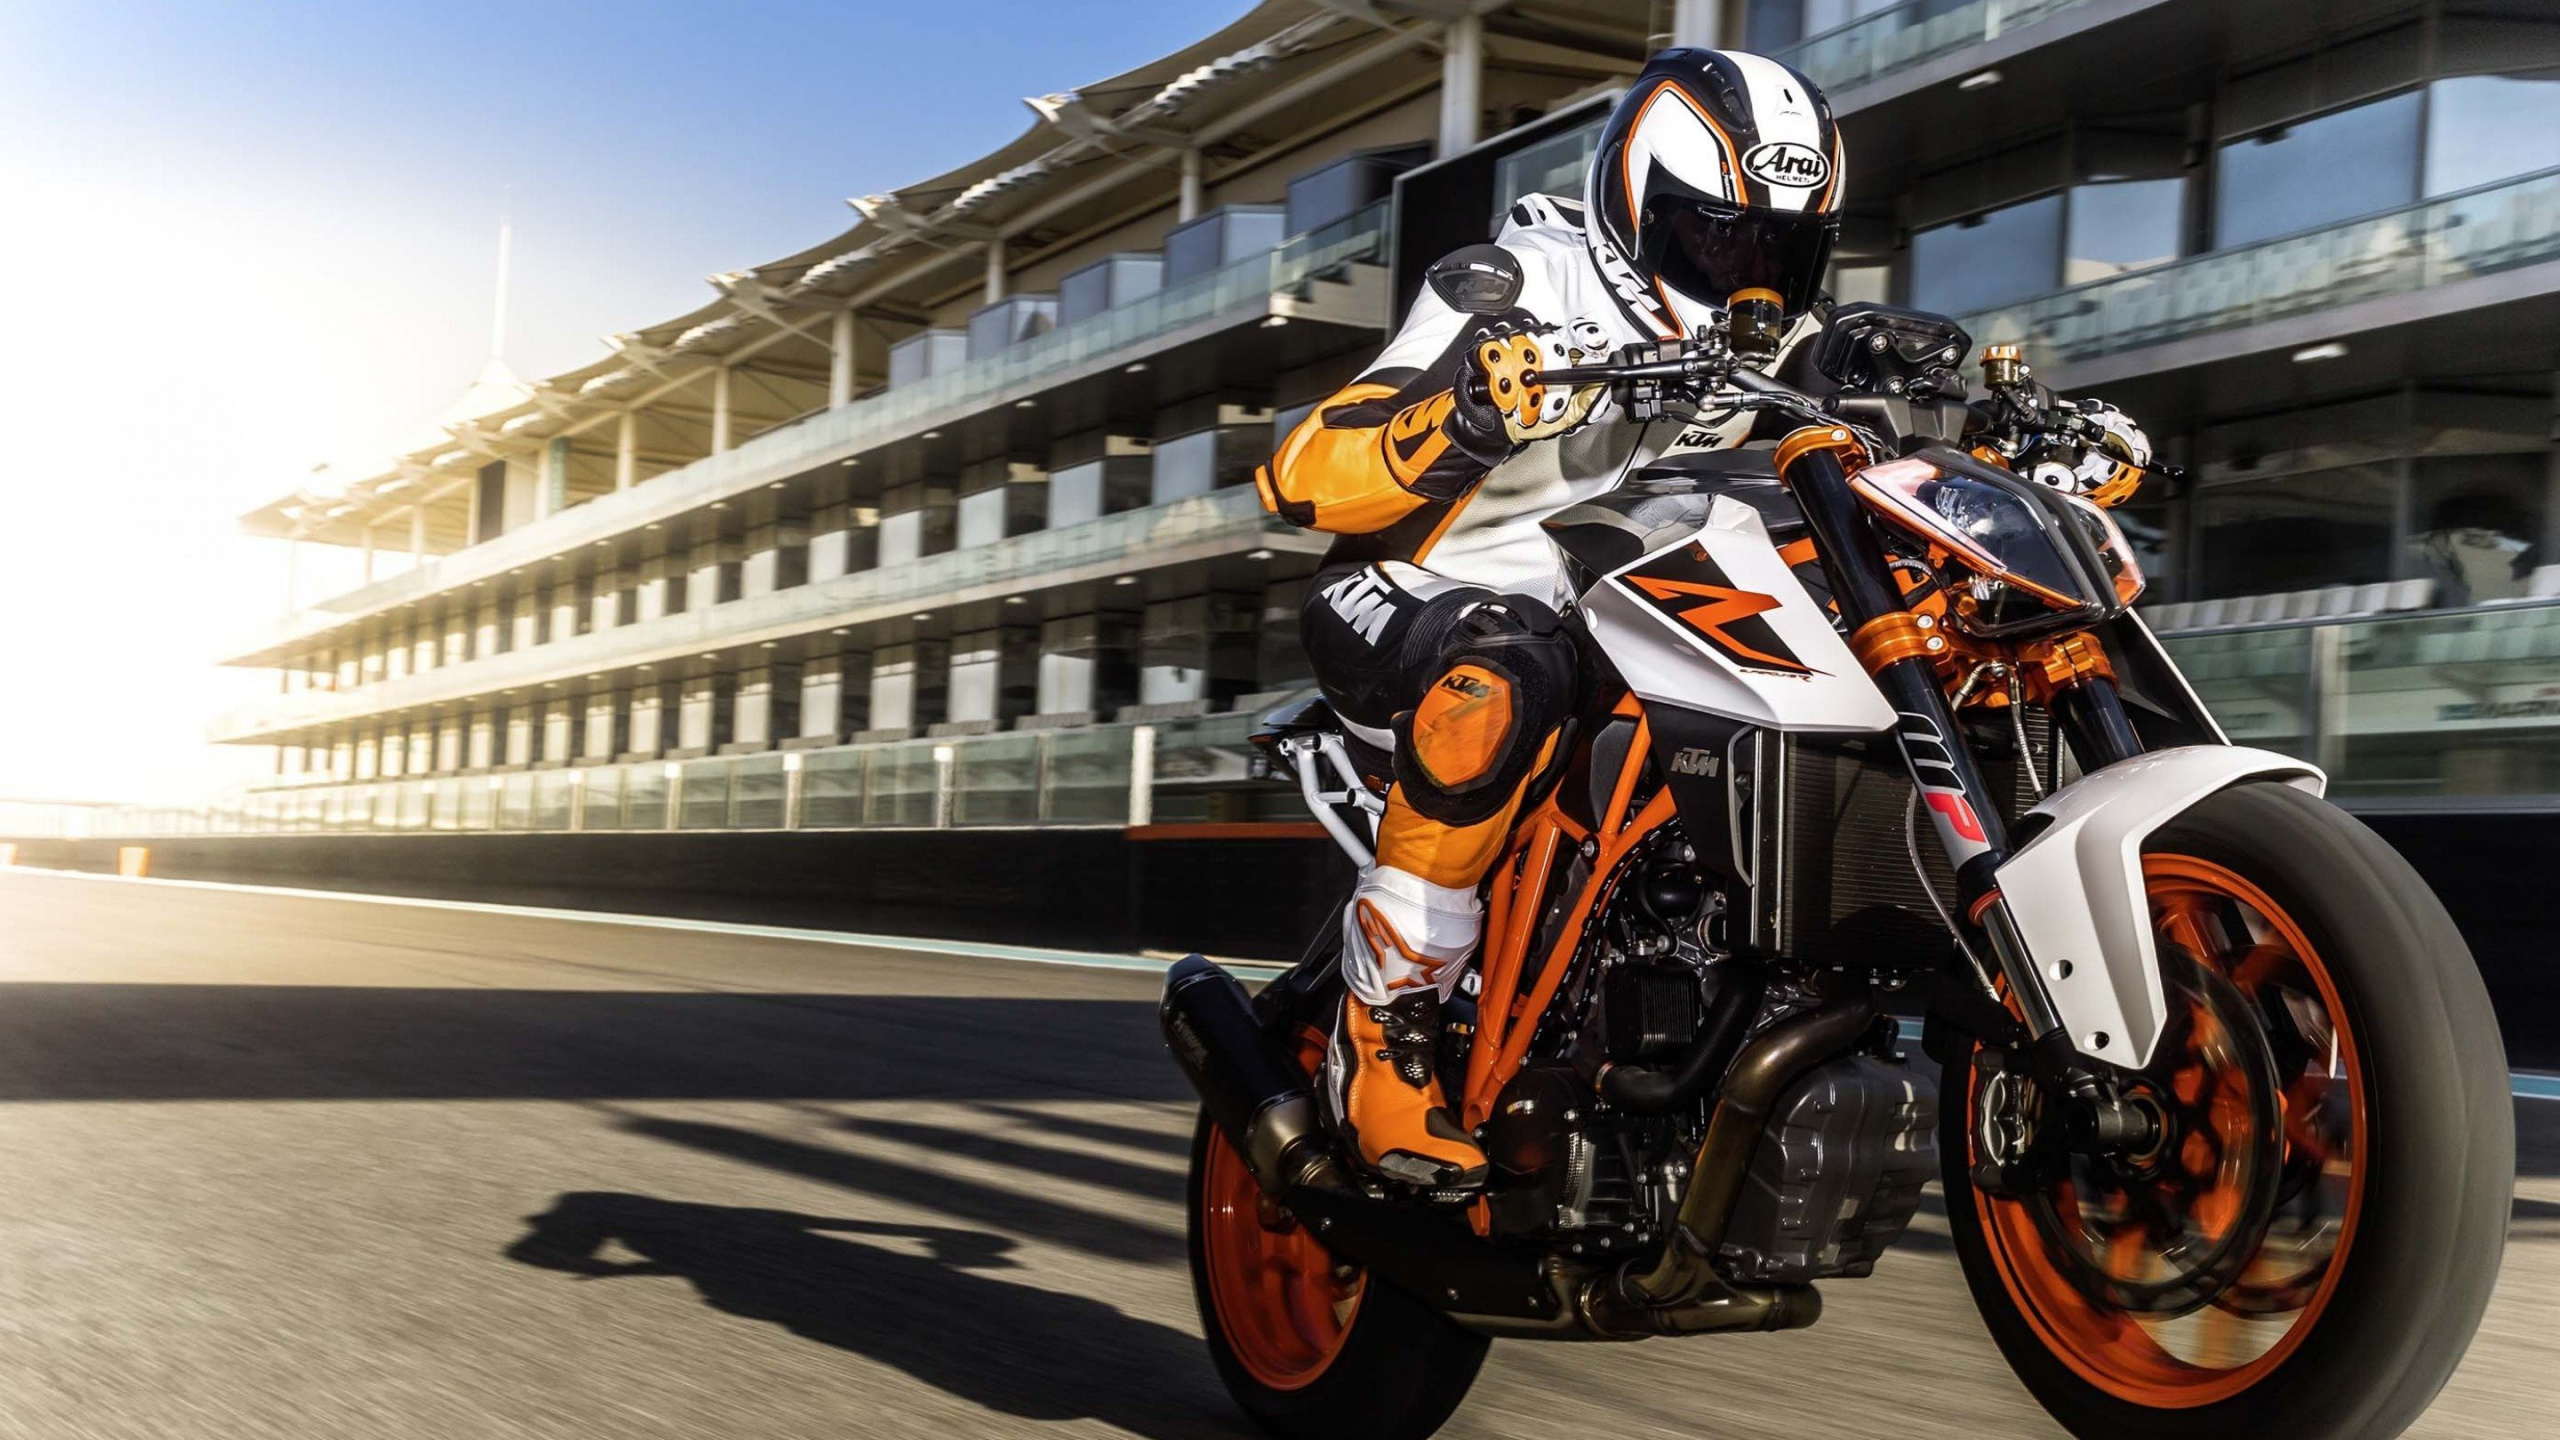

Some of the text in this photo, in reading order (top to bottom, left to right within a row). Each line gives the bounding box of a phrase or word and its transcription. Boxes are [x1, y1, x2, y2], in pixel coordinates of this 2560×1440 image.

[1752, 146, 1822, 177] Arai
[1590, 238, 1662, 318] KTM
[1674, 430, 1724, 448] KTM
[1321, 565, 1397, 647] KTM
[1441, 674, 1491, 699] KTM
[1671, 747, 1720, 778] KTM
